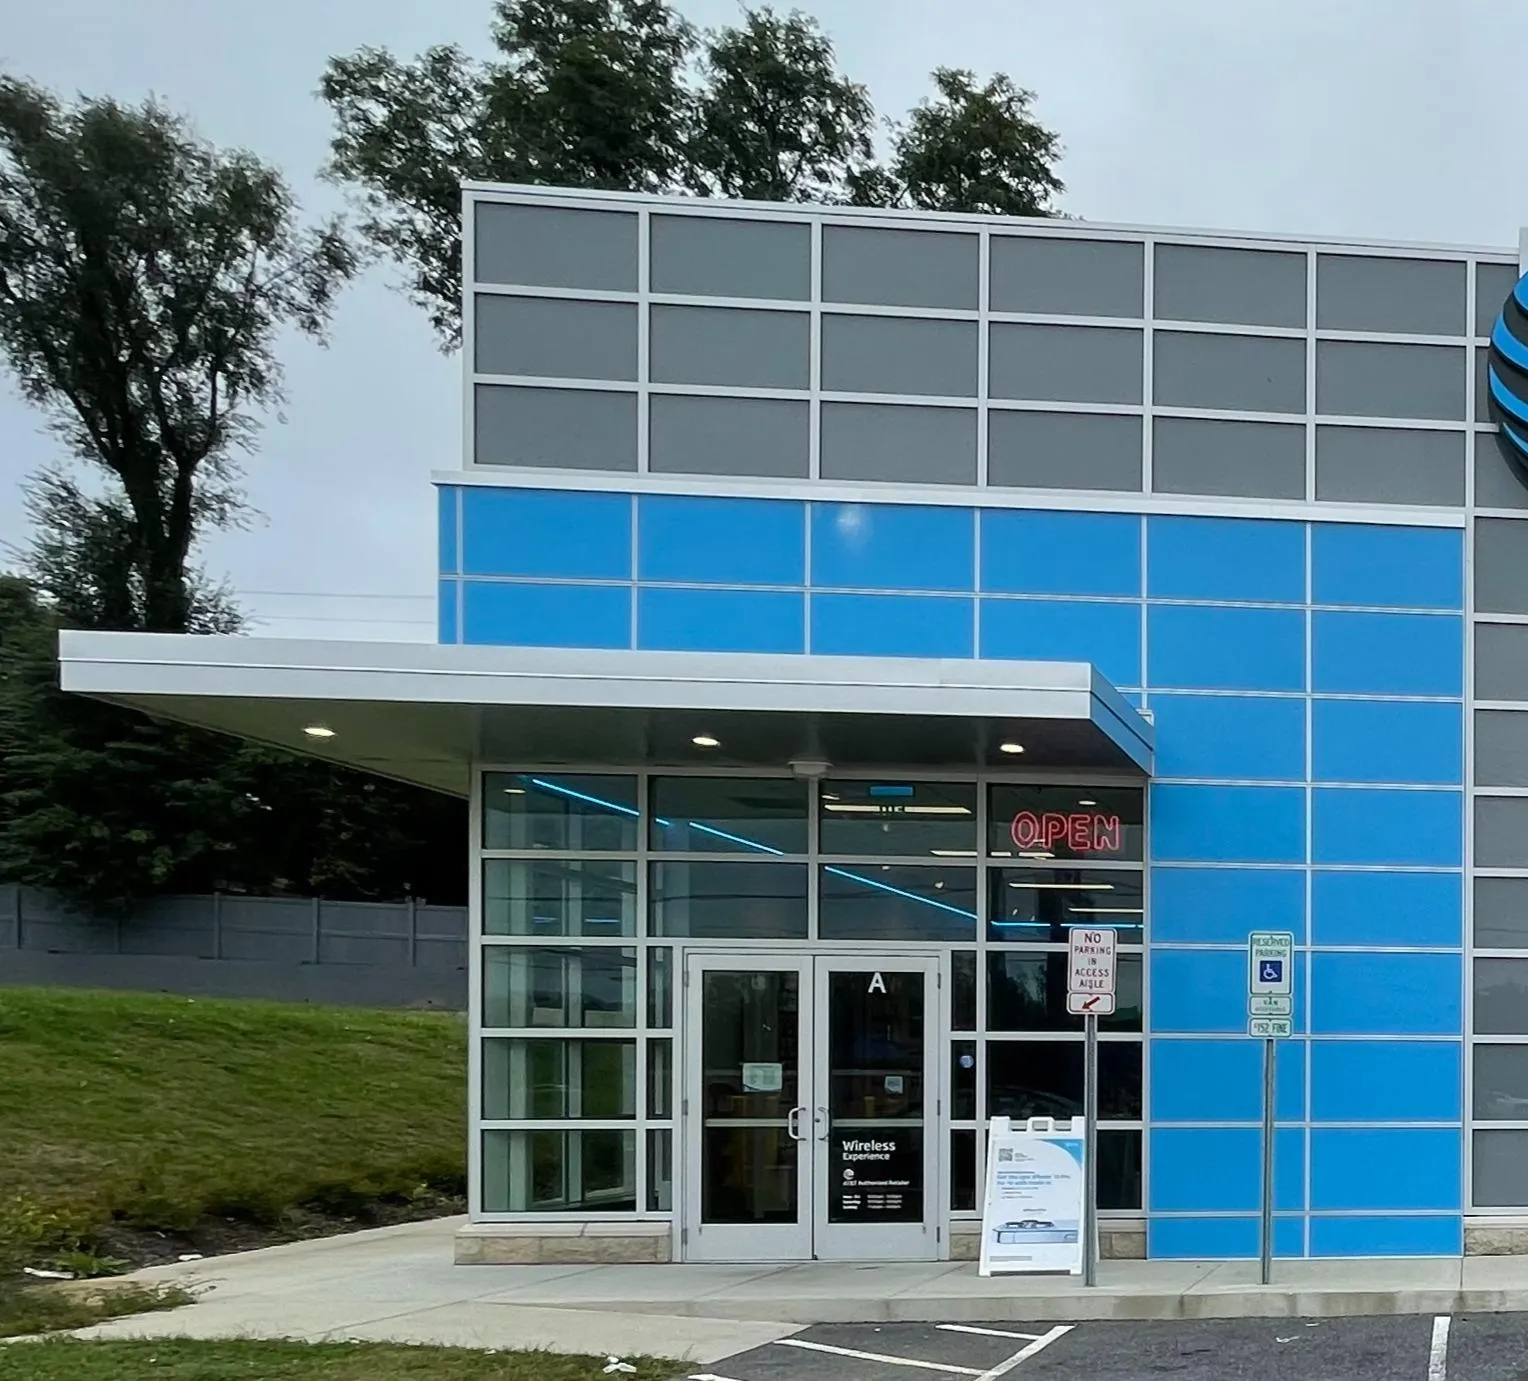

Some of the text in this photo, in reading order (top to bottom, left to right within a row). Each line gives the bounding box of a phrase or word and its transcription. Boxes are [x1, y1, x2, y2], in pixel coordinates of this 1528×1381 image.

[1011, 811, 1120, 851] OPEN
[1084, 933, 1102, 944] NO
[1253, 938, 1290, 947] RESERVED
[1074, 945, 1112, 956] PARKING
[1255, 949, 1288, 958] PARKING
[1088, 957, 1097, 966] IN
[1074, 968, 1110, 978] ACCESS
[868, 972, 887, 993] A
[1079, 979, 1105, 989] AISLE
[842, 1140, 896, 1151] Wireless
[842, 1153, 891, 1162] Experience
